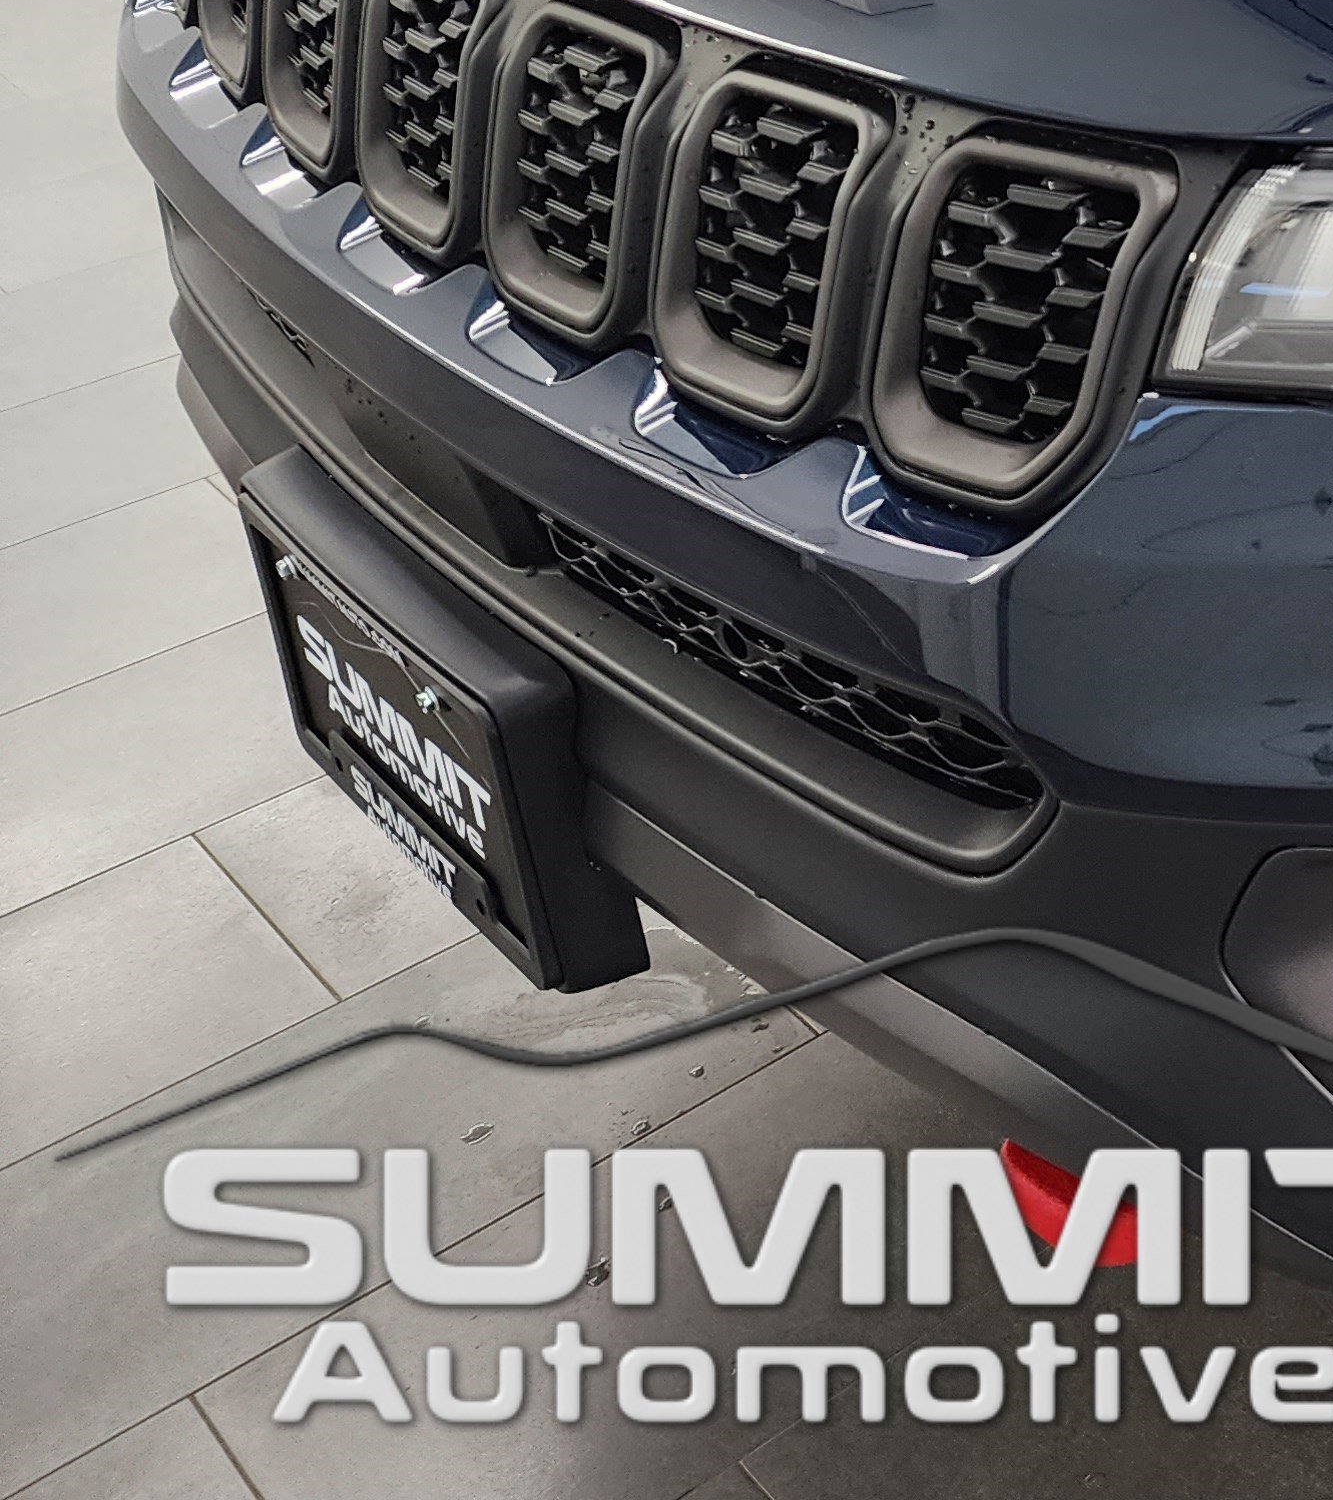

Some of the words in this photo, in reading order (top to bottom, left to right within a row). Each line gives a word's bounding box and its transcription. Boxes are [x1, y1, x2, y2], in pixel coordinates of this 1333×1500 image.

[297, 614, 491, 832] SUMMIT
[328, 683, 486, 861] Automotive
[351, 764, 456, 888] SUMMIT
